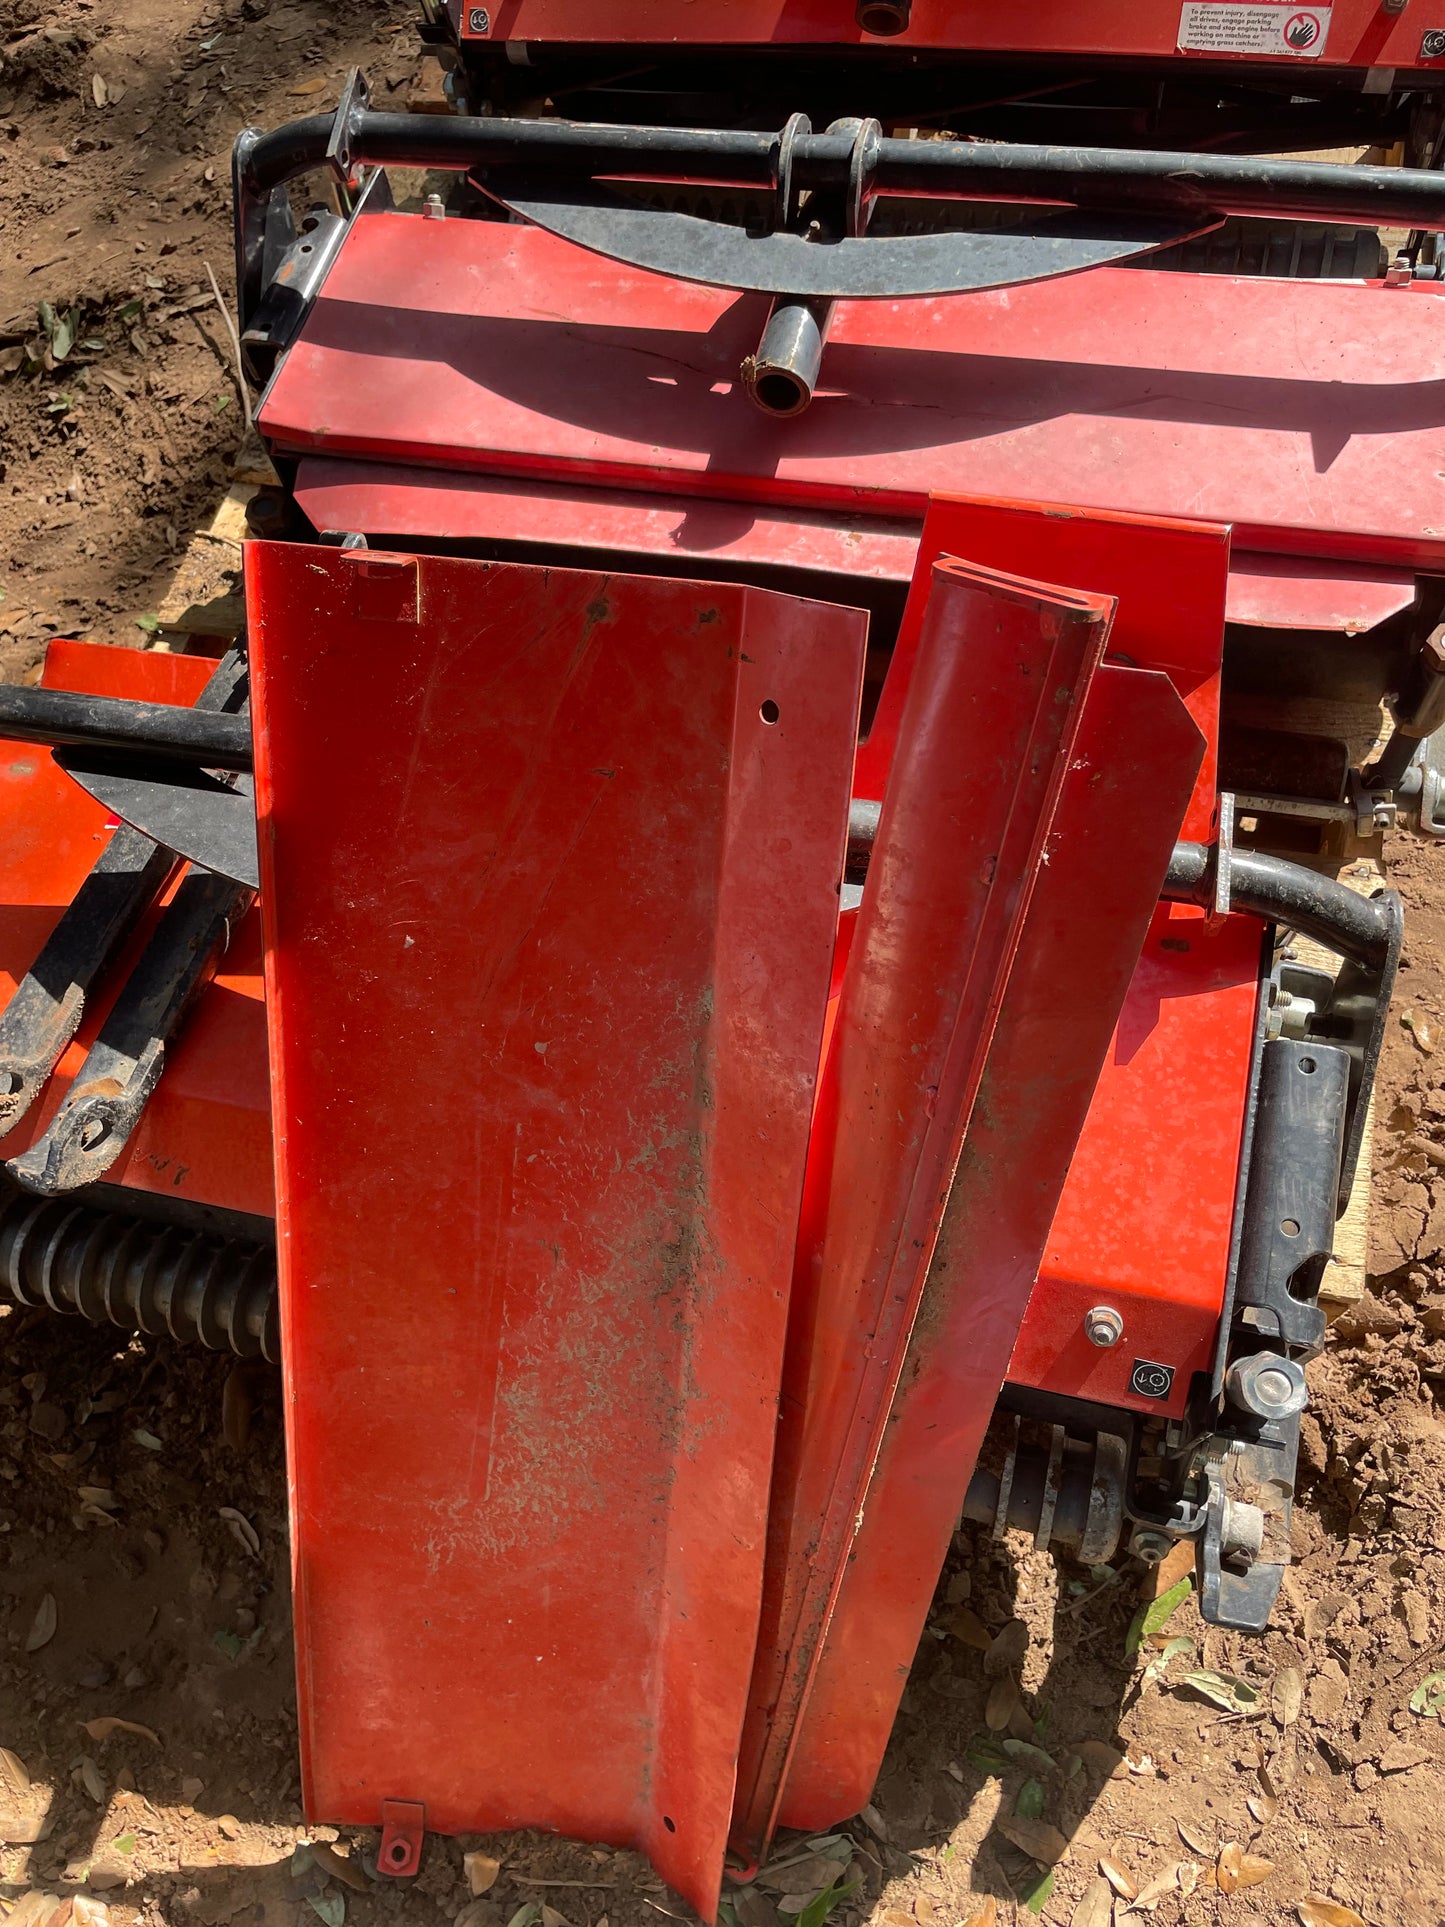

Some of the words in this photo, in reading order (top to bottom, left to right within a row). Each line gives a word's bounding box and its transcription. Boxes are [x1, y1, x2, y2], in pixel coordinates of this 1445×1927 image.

[1246, 18, 1272, 26] parking
[1260, 25, 1281, 33] before
[1235, 39, 1263, 47] catchers.
